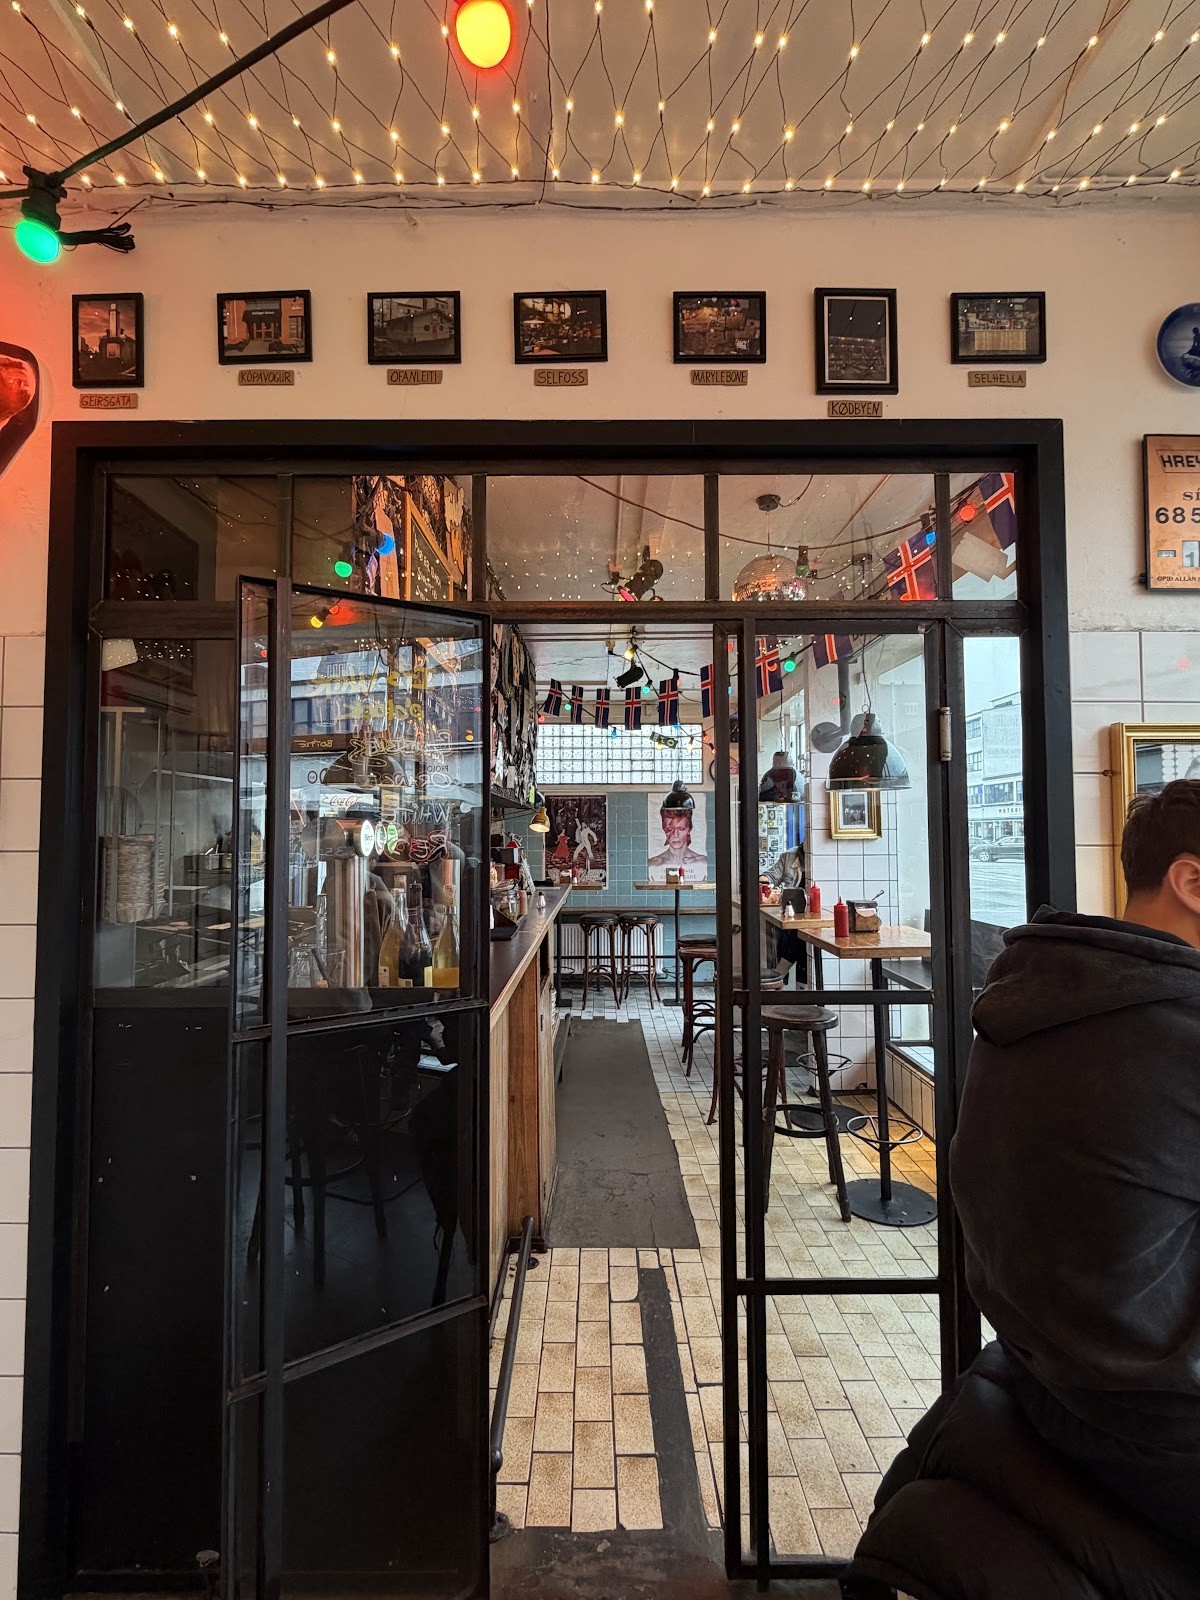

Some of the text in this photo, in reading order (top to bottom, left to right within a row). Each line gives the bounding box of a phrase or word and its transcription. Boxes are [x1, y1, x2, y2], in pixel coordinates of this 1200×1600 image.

[390, 370, 438, 383] OFANLEITI
[537, 371, 586, 384] SELFOSS
[691, 371, 747, 384] MARYLEBONE
[81, 395, 131, 407] GEIRSGATA
[831, 401, 880, 416] KØDBYEN
[1155, 507, 1200, 524] 685
